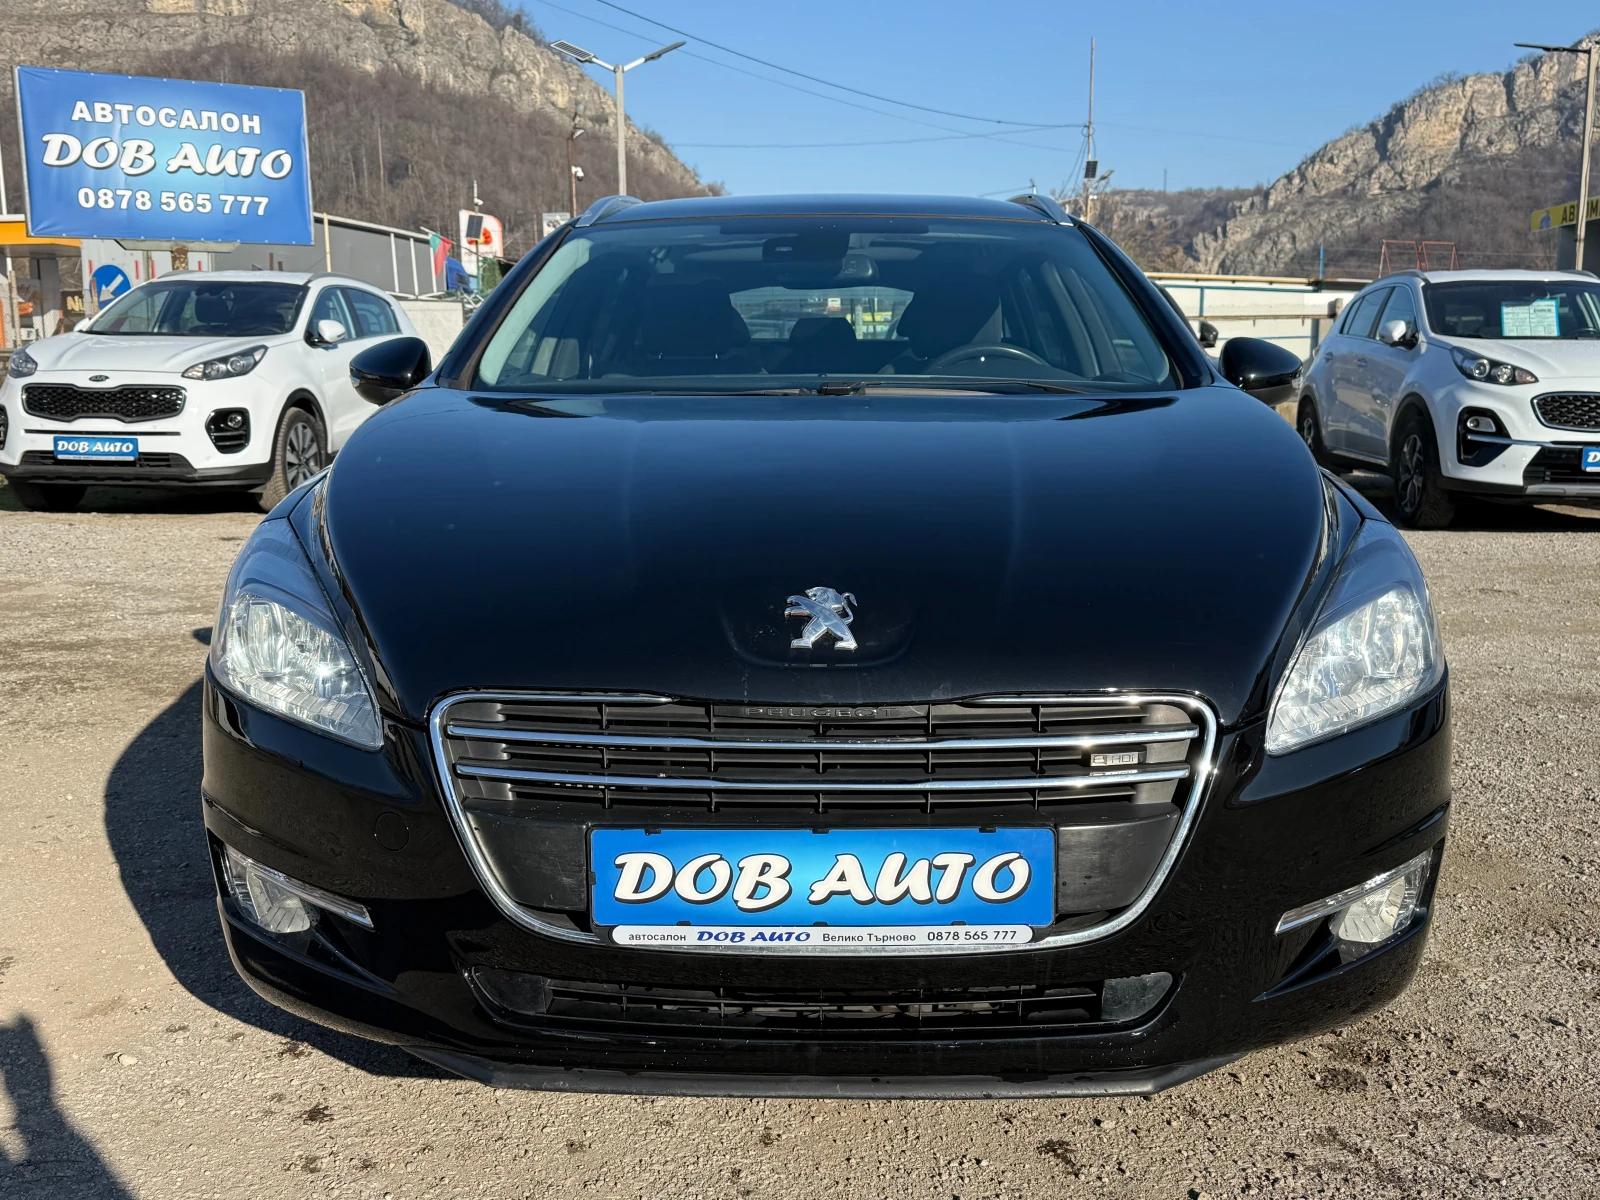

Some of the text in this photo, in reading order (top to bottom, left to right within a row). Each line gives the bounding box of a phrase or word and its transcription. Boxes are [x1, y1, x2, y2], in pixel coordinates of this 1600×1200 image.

[71, 100, 261, 135] АВТОСАЛОН
[41, 133, 293, 179] DOB AUTO
[77, 187, 269, 216] 0878 565 777
[57, 441, 134, 453] DOB AUTO
[744, 707, 897, 717] PEUGEOT
[614, 852, 1032, 913] DOB AUTO
[628, 930, 1018, 943] автосалон DOB AUTO Велико Търново 0878 565 777
